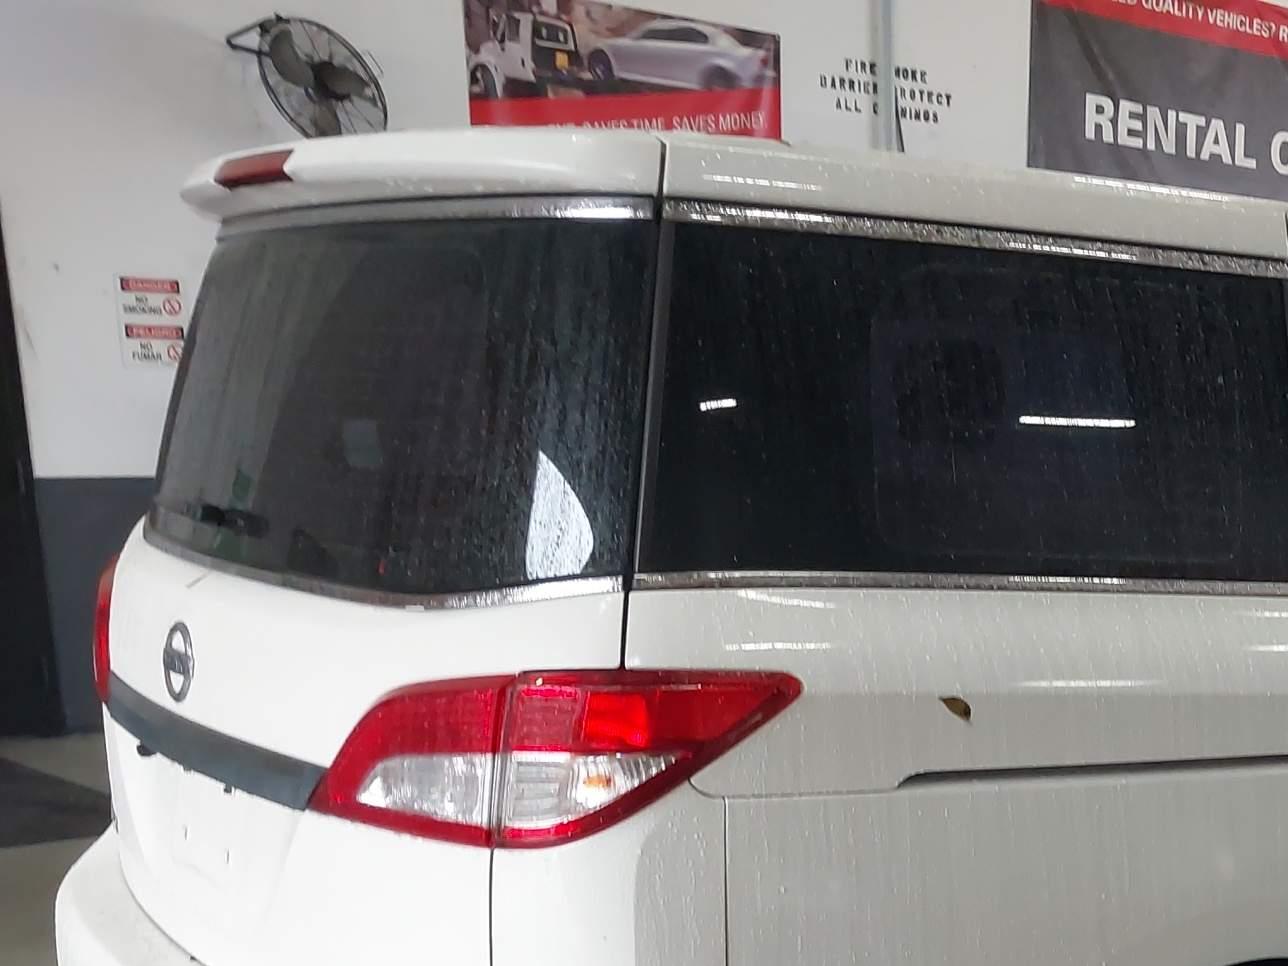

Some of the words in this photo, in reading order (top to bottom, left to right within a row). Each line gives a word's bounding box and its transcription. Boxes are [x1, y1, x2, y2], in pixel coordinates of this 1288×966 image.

[1206, 8, 1276, 38] VEHICLES?
[819, 74, 879, 95] BARRIER
[835, 96, 862, 113] ALL
[672, 112, 716, 134] SAVES
[1085, 92, 1257, 170] RENTAL
[135, 295, 148, 303] NO
[122, 303, 163, 315] SMOKING
[140, 341, 153, 351] NO
[132, 350, 163, 361] FUMAR
